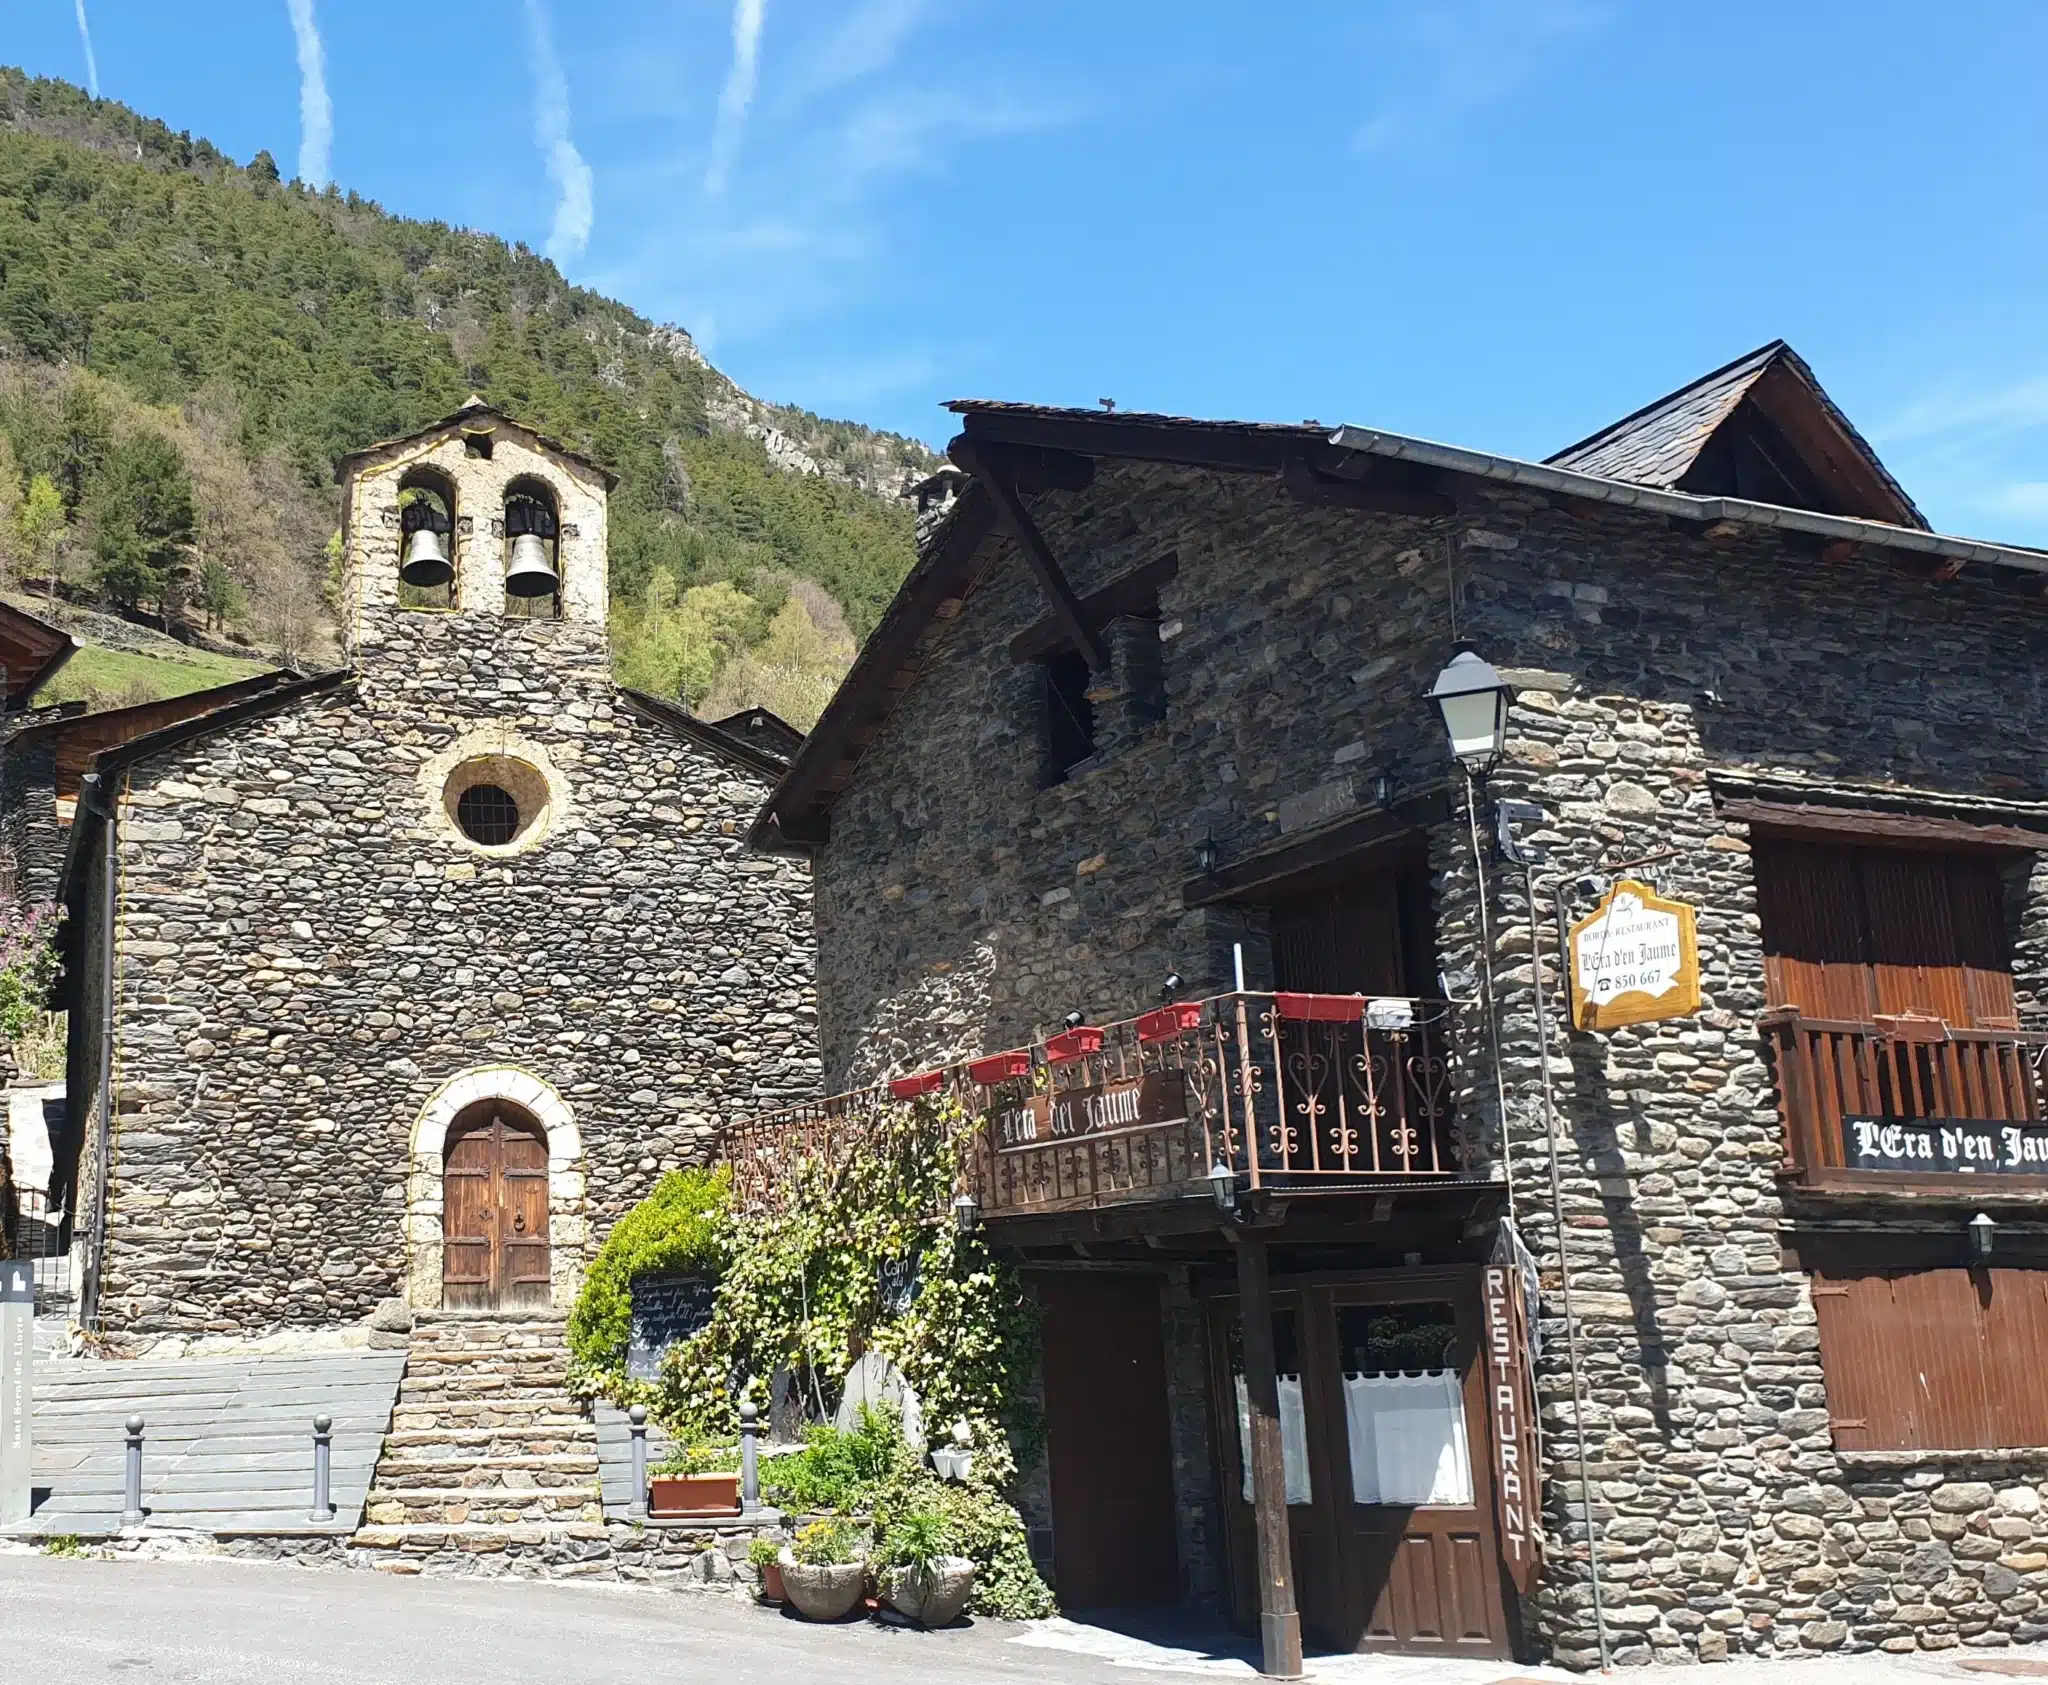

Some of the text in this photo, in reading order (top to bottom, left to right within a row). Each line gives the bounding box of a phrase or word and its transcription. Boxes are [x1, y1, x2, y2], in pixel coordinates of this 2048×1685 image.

[1614, 948, 1635, 967] d'en
[1638, 943, 1676, 966] Jaume
[1615, 969, 1661, 989] 850 667
[1082, 1087, 1142, 1136] Jaume
[1853, 1120, 1933, 1159] L'Era
[1940, 1126, 1994, 1161] d'en
[13, 1360, 23, 1376] de
[1487, 1269, 1525, 1561] RESTAURANT
